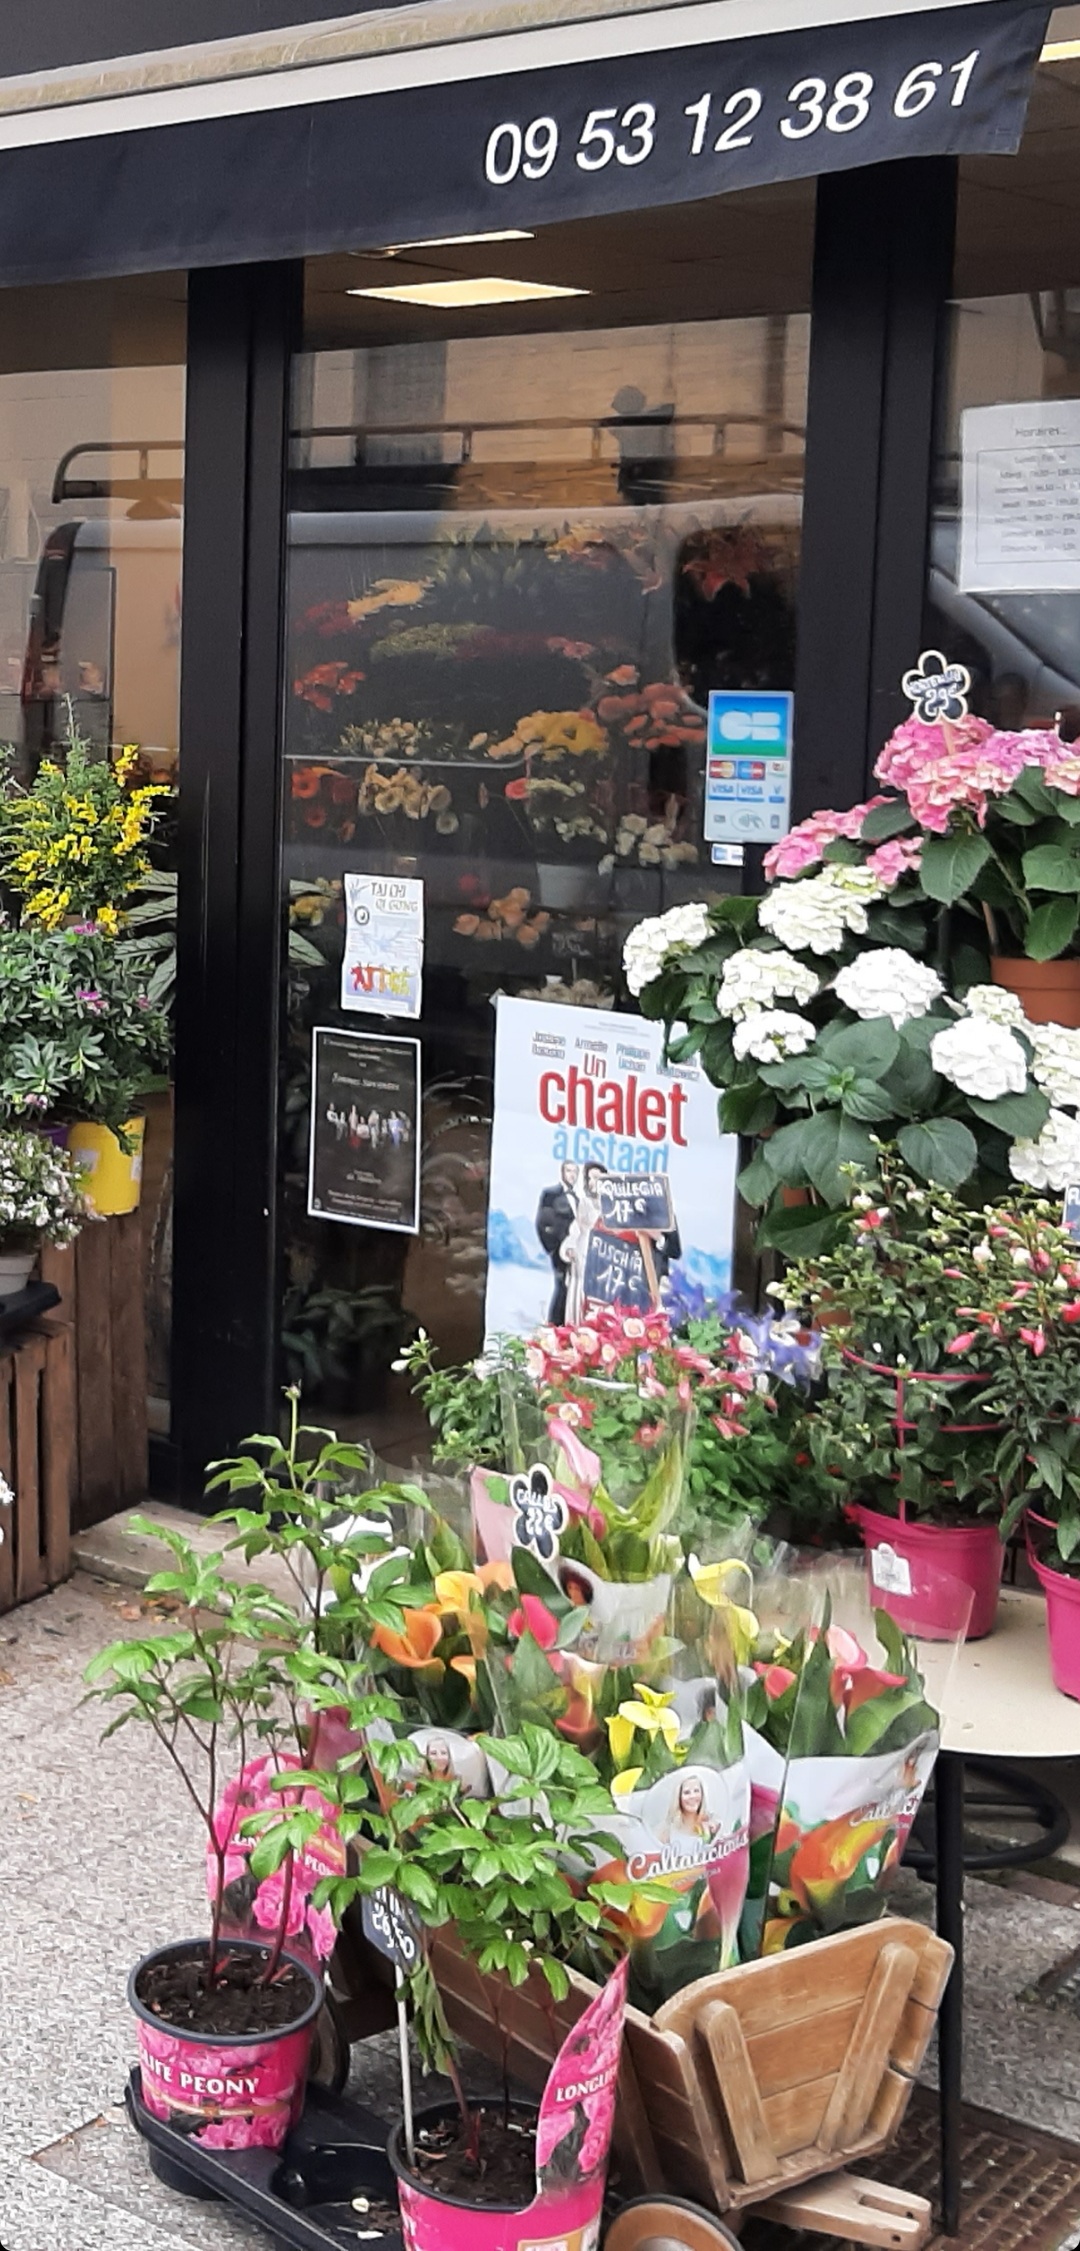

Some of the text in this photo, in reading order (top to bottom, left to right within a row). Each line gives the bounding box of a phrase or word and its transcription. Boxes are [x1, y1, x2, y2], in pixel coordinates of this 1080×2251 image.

[485, 50, 980, 186] 09 53 12 38 61
[584, 1053, 607, 1078] Un
[540, 1065, 688, 1147] chalet
[553, 1126, 669, 1174] à Gstaad
[180, 2071, 259, 2095] PEONY
